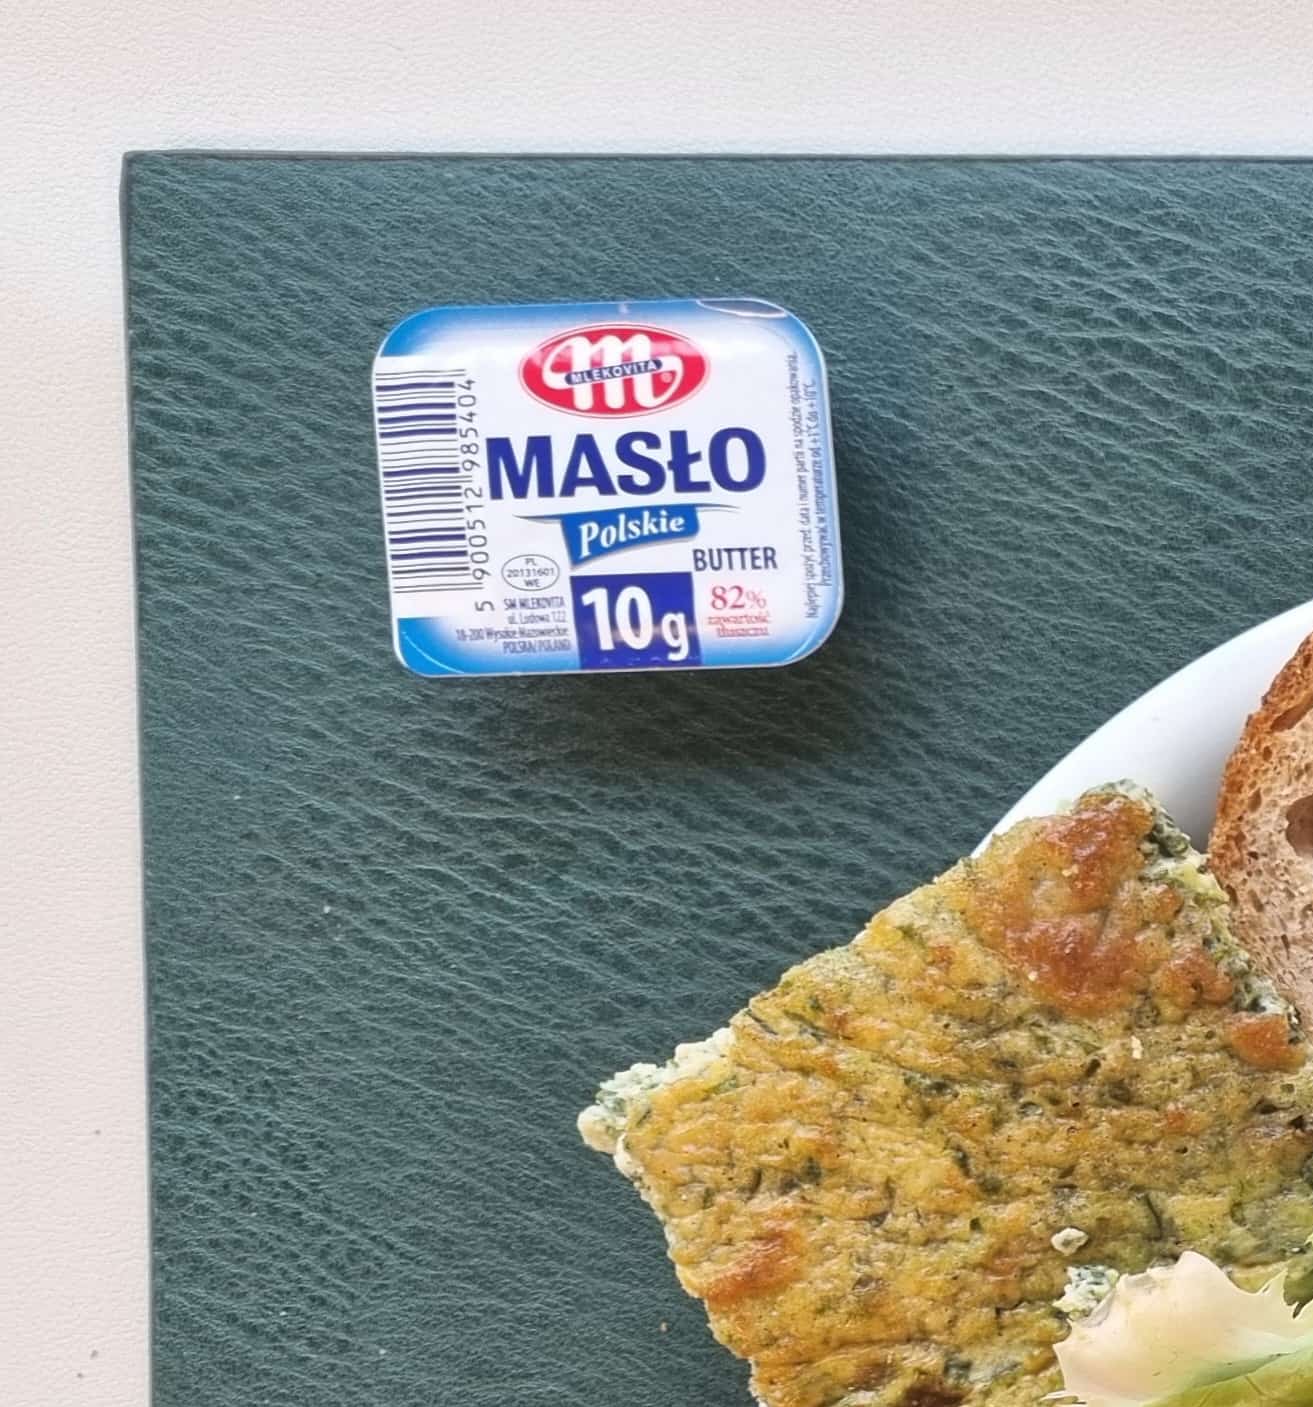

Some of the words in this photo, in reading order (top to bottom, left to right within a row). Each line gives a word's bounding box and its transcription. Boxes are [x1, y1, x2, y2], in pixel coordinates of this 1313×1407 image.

[571, 360, 658, 385] MLEKOVITA
[457, 379, 481, 472] 985404
[485, 427, 767, 501] MASŁO
[464, 486, 492, 581] 900512
[578, 508, 686, 560] Polskie
[692, 546, 779, 572] BUTTER
[474, 600, 495, 612] 5
